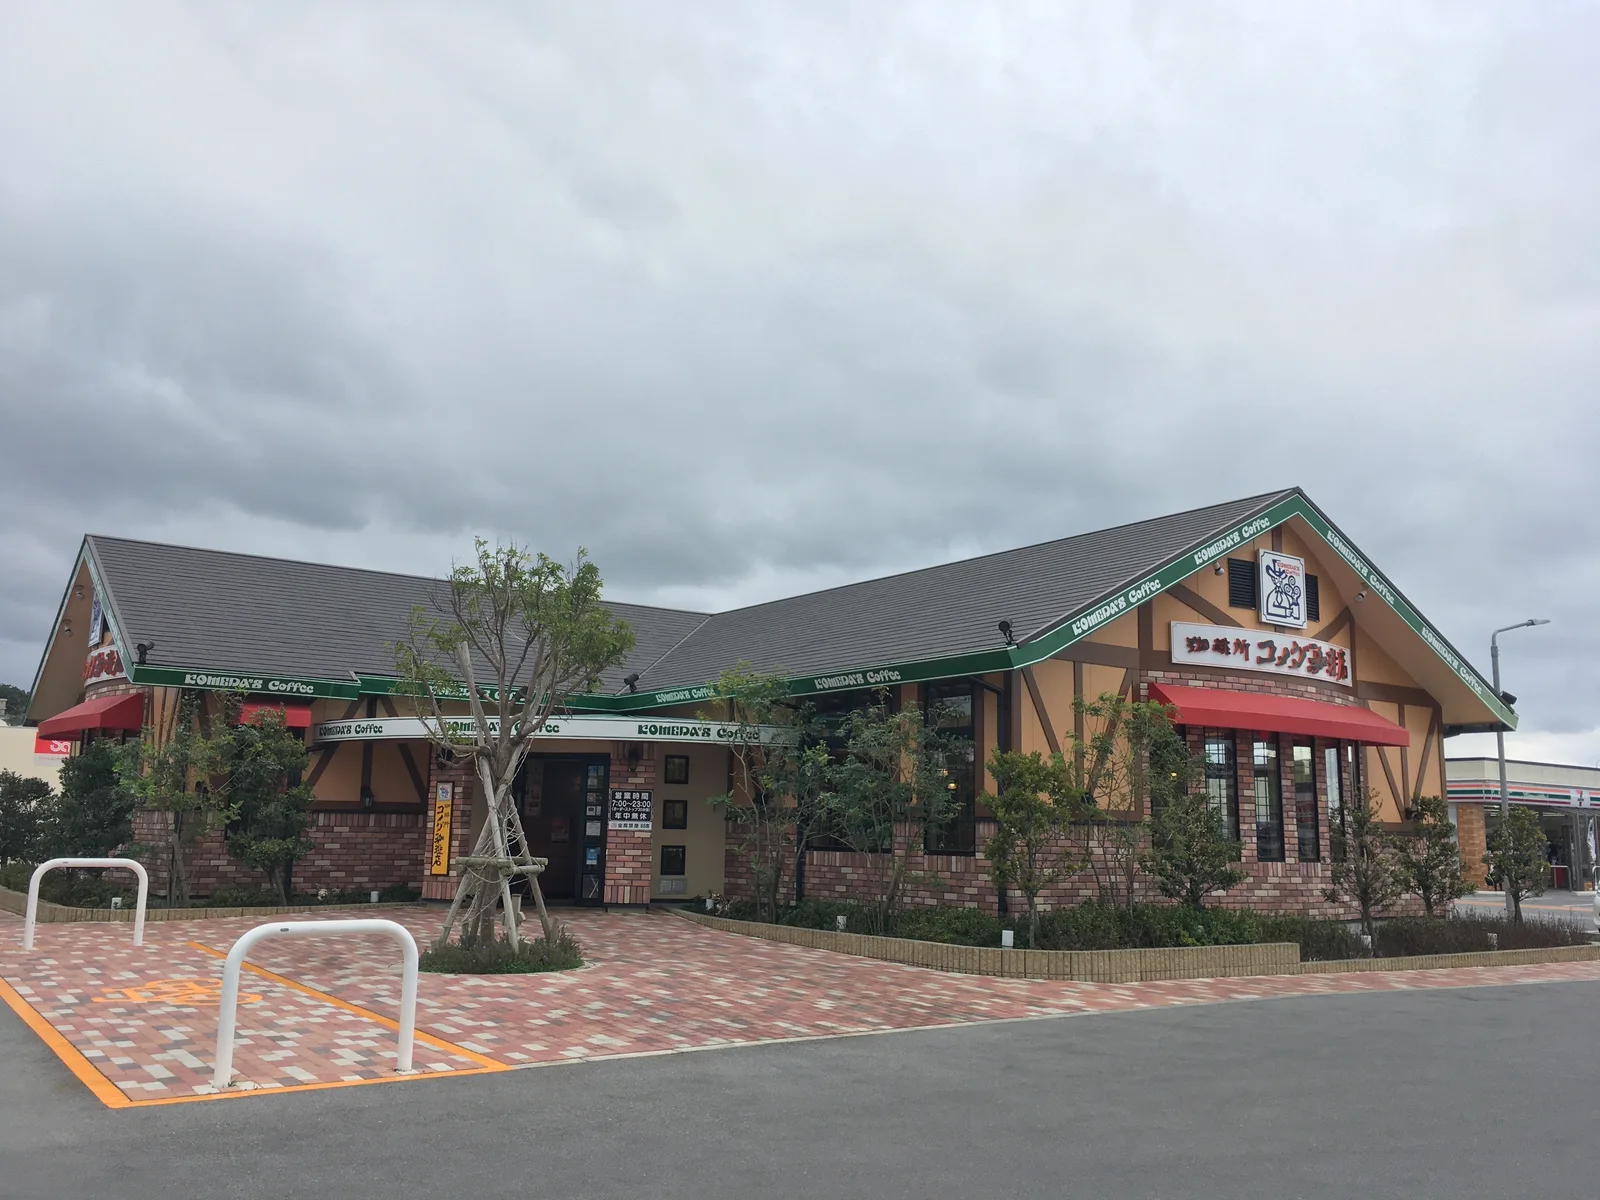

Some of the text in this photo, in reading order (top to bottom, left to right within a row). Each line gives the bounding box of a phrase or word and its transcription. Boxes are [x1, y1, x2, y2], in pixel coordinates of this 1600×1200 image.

[1194, 517, 1270, 565] KOMEDA'S Coffee
[1326, 530, 1395, 605] KOMEDA'S Coffee
[1071, 579, 1161, 636] KOMEDA'S Coffee
[1421, 627, 1482, 695] KOMEDA'S Coffee
[184, 674, 314, 694] KOMEDA'S Coffee
[814, 669, 901, 689] KOMEDA'S Coffee
[355, 723, 383, 735] Coffee
[637, 724, 711, 738] KOMEDA'S
[614, 812, 647, 820] 年中無休
